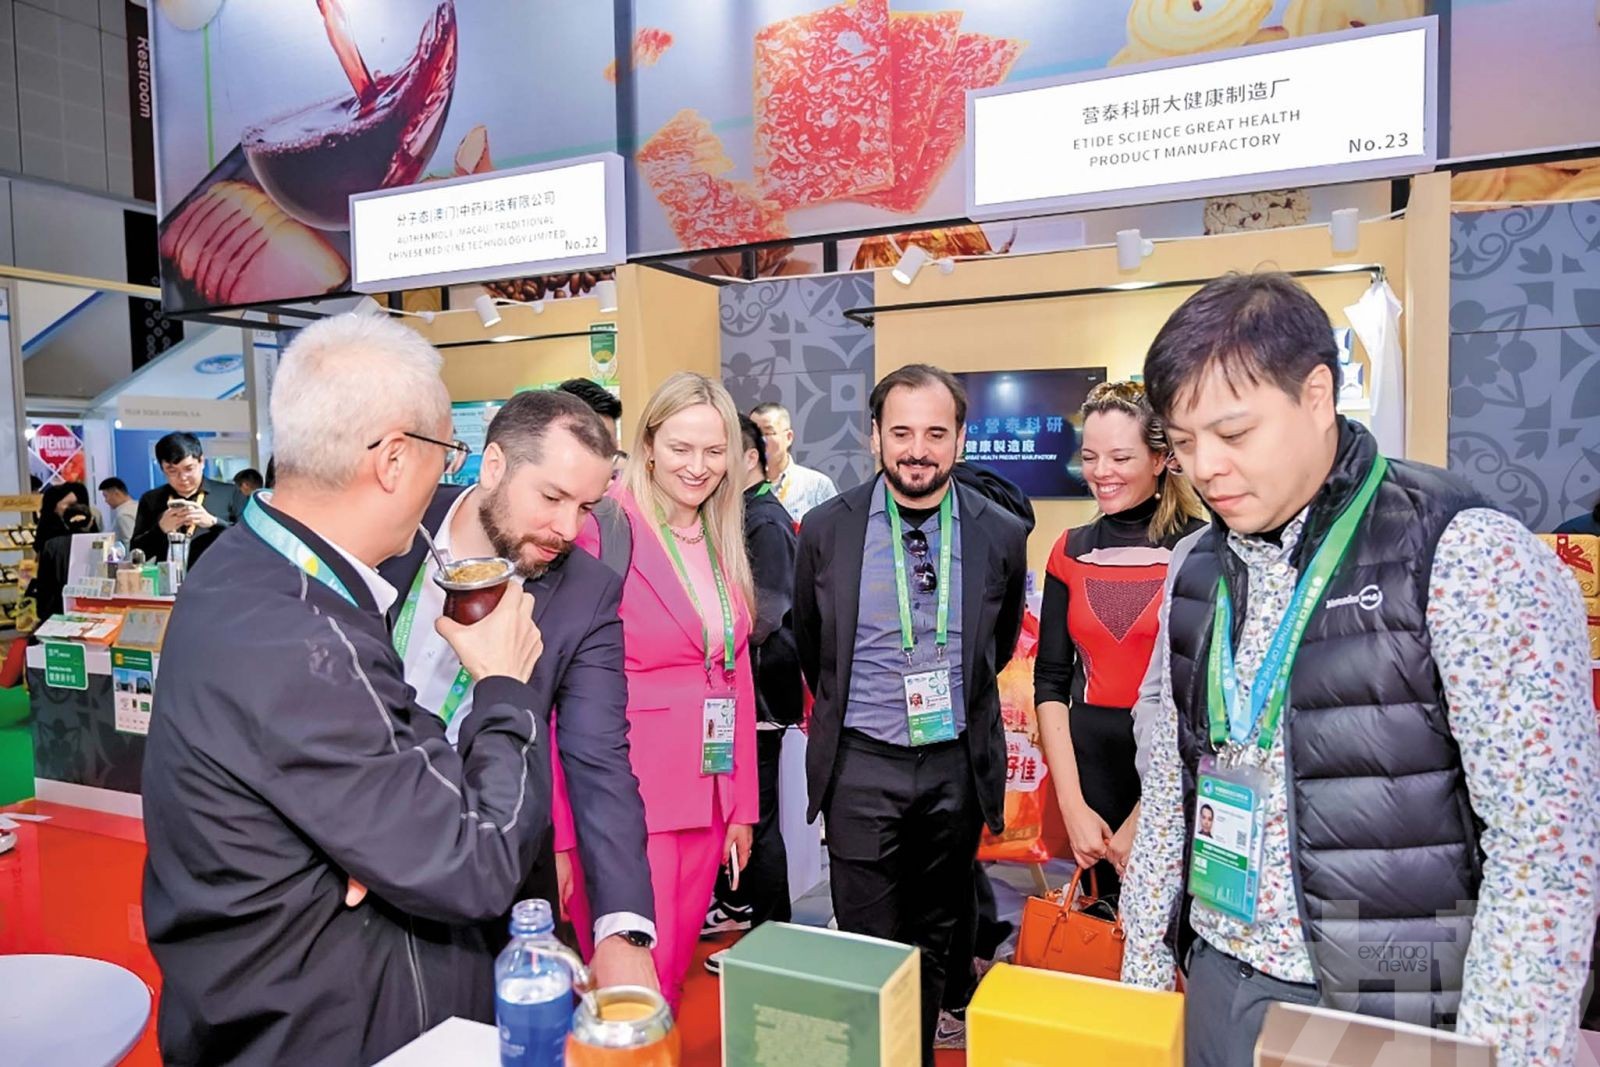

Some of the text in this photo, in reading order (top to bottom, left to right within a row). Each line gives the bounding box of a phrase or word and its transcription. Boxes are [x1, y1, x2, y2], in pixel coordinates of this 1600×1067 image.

[137, 36, 151, 118] Restroom
[1083, 78, 1291, 125] 营泰科研大健康制造厂
[1073, 109, 1301, 151] ETIDE SCIENCE GREAT HEALTH
[1348, 132, 1409, 154] No.23
[1089, 133, 1281, 168] PRODUCT MANUFACTORY
[492, 216, 554, 232] TRADITIONAL
[389, 229, 566, 261] CHINESE MEDICINE TECHNOLOGY LIMITED
[565, 236, 598, 250] No.22
